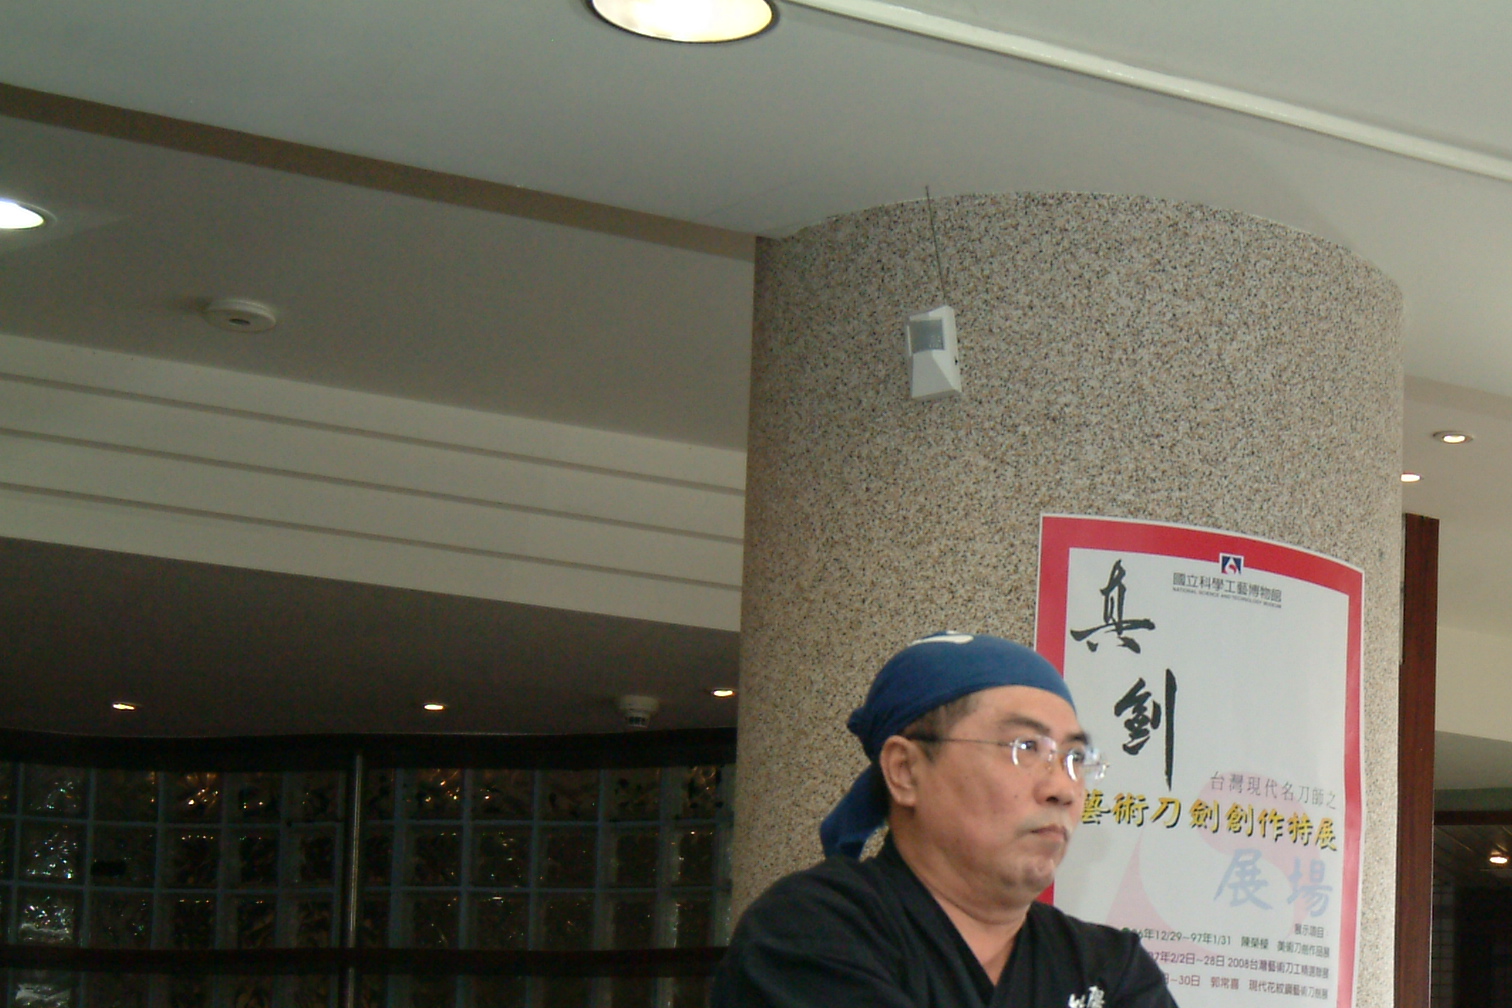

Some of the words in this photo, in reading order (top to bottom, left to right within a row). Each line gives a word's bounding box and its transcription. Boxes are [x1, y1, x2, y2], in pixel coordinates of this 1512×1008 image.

[1173, 572, 1282, 602] 國立科學工藝博物館
[1213, 848, 1334, 918] 展場
